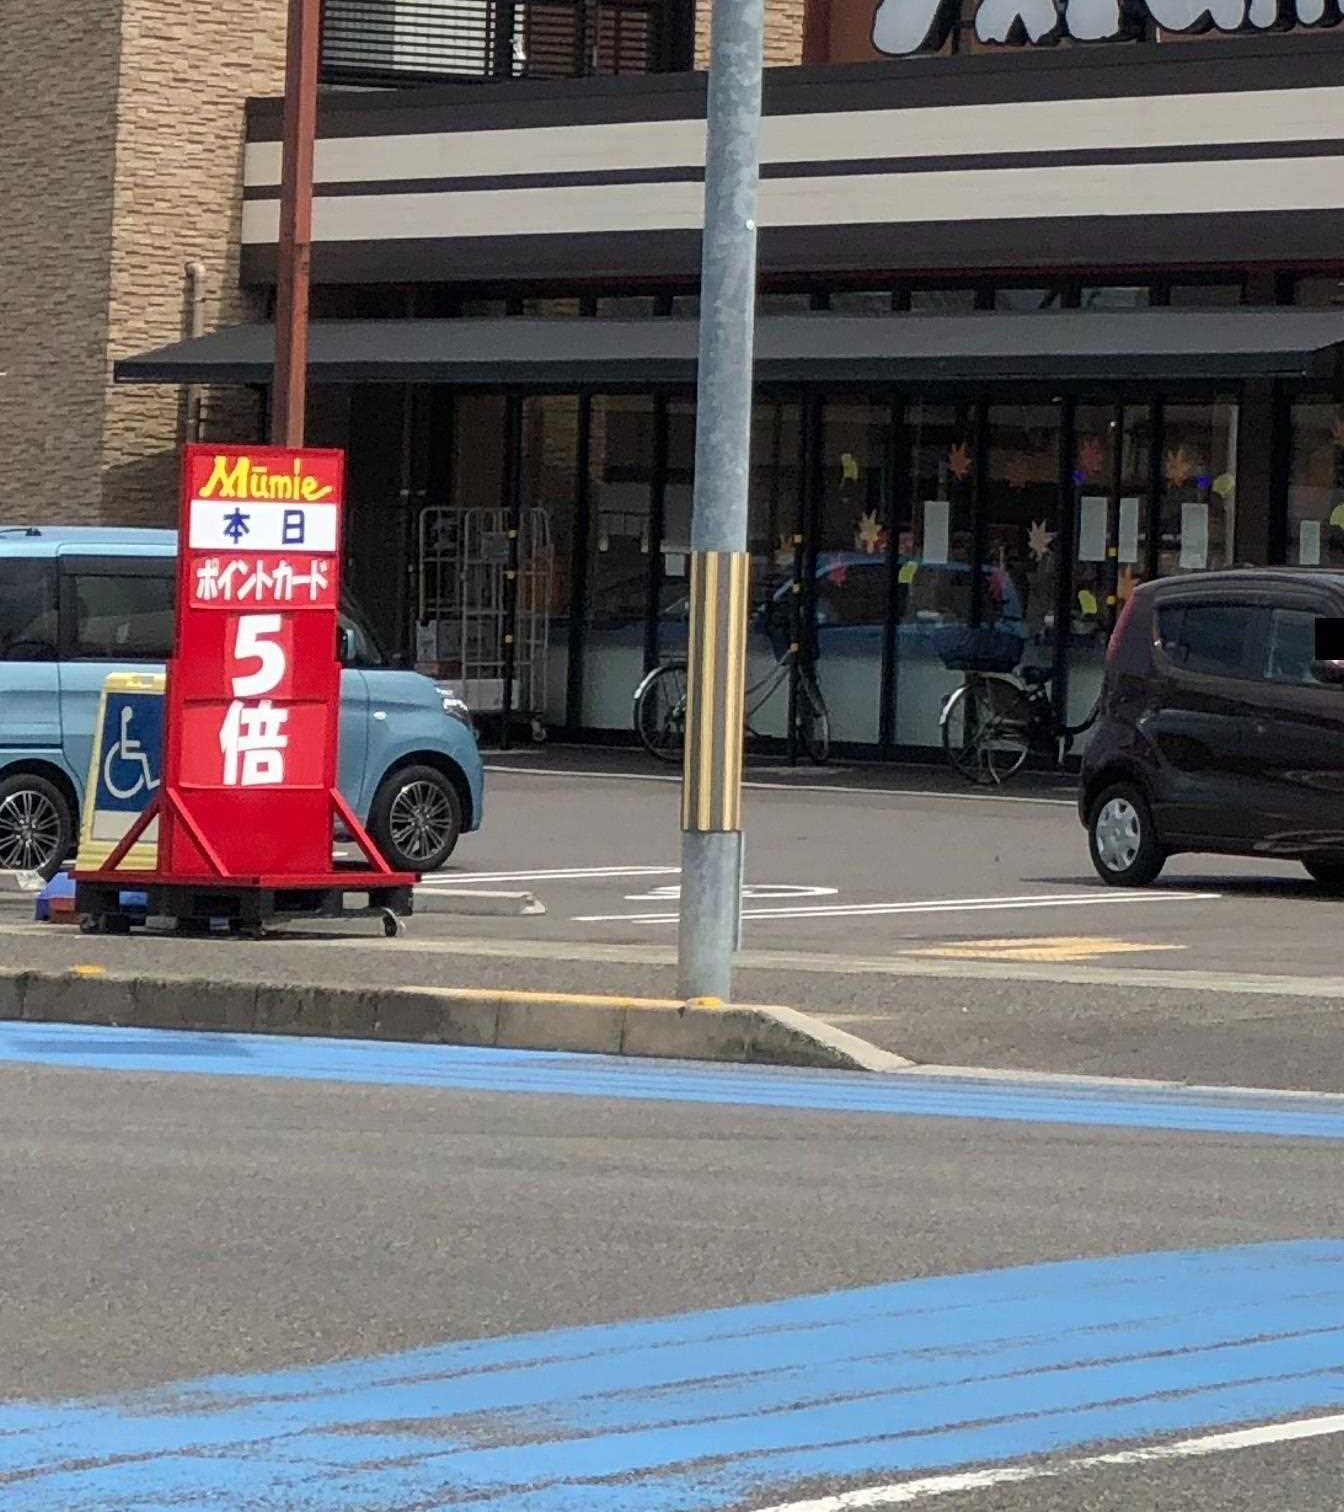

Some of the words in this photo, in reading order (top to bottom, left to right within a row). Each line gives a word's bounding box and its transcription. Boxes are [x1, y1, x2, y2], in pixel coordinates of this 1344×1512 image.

[223, 507, 305, 544] 本日
[196, 558, 329, 600] ポイントカード
